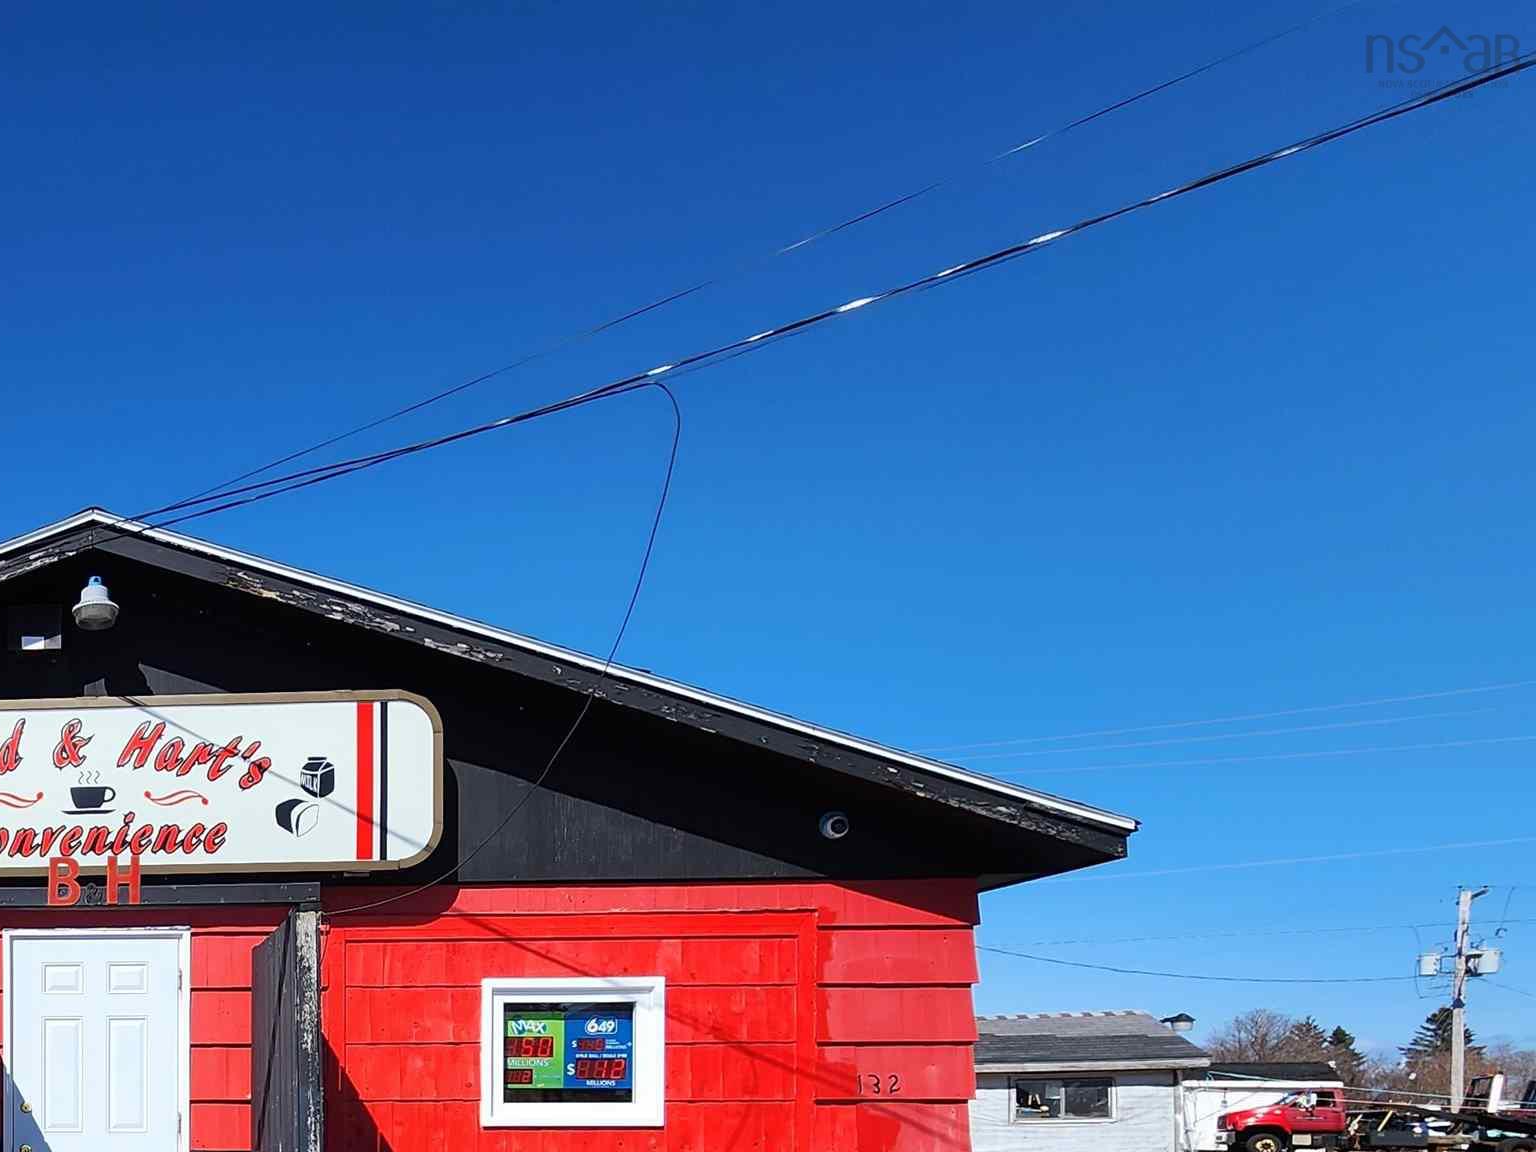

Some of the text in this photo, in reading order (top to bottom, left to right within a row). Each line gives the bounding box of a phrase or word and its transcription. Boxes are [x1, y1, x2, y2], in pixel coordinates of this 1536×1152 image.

[52, 717, 94, 770] &
[116, 719, 272, 791] Hart's
[48, 857, 81, 906] B
[107, 855, 141, 905] H
[511, 1019, 546, 1035] MAX
[587, 1017, 616, 1033] 649
[857, 1073, 902, 1095] 132
